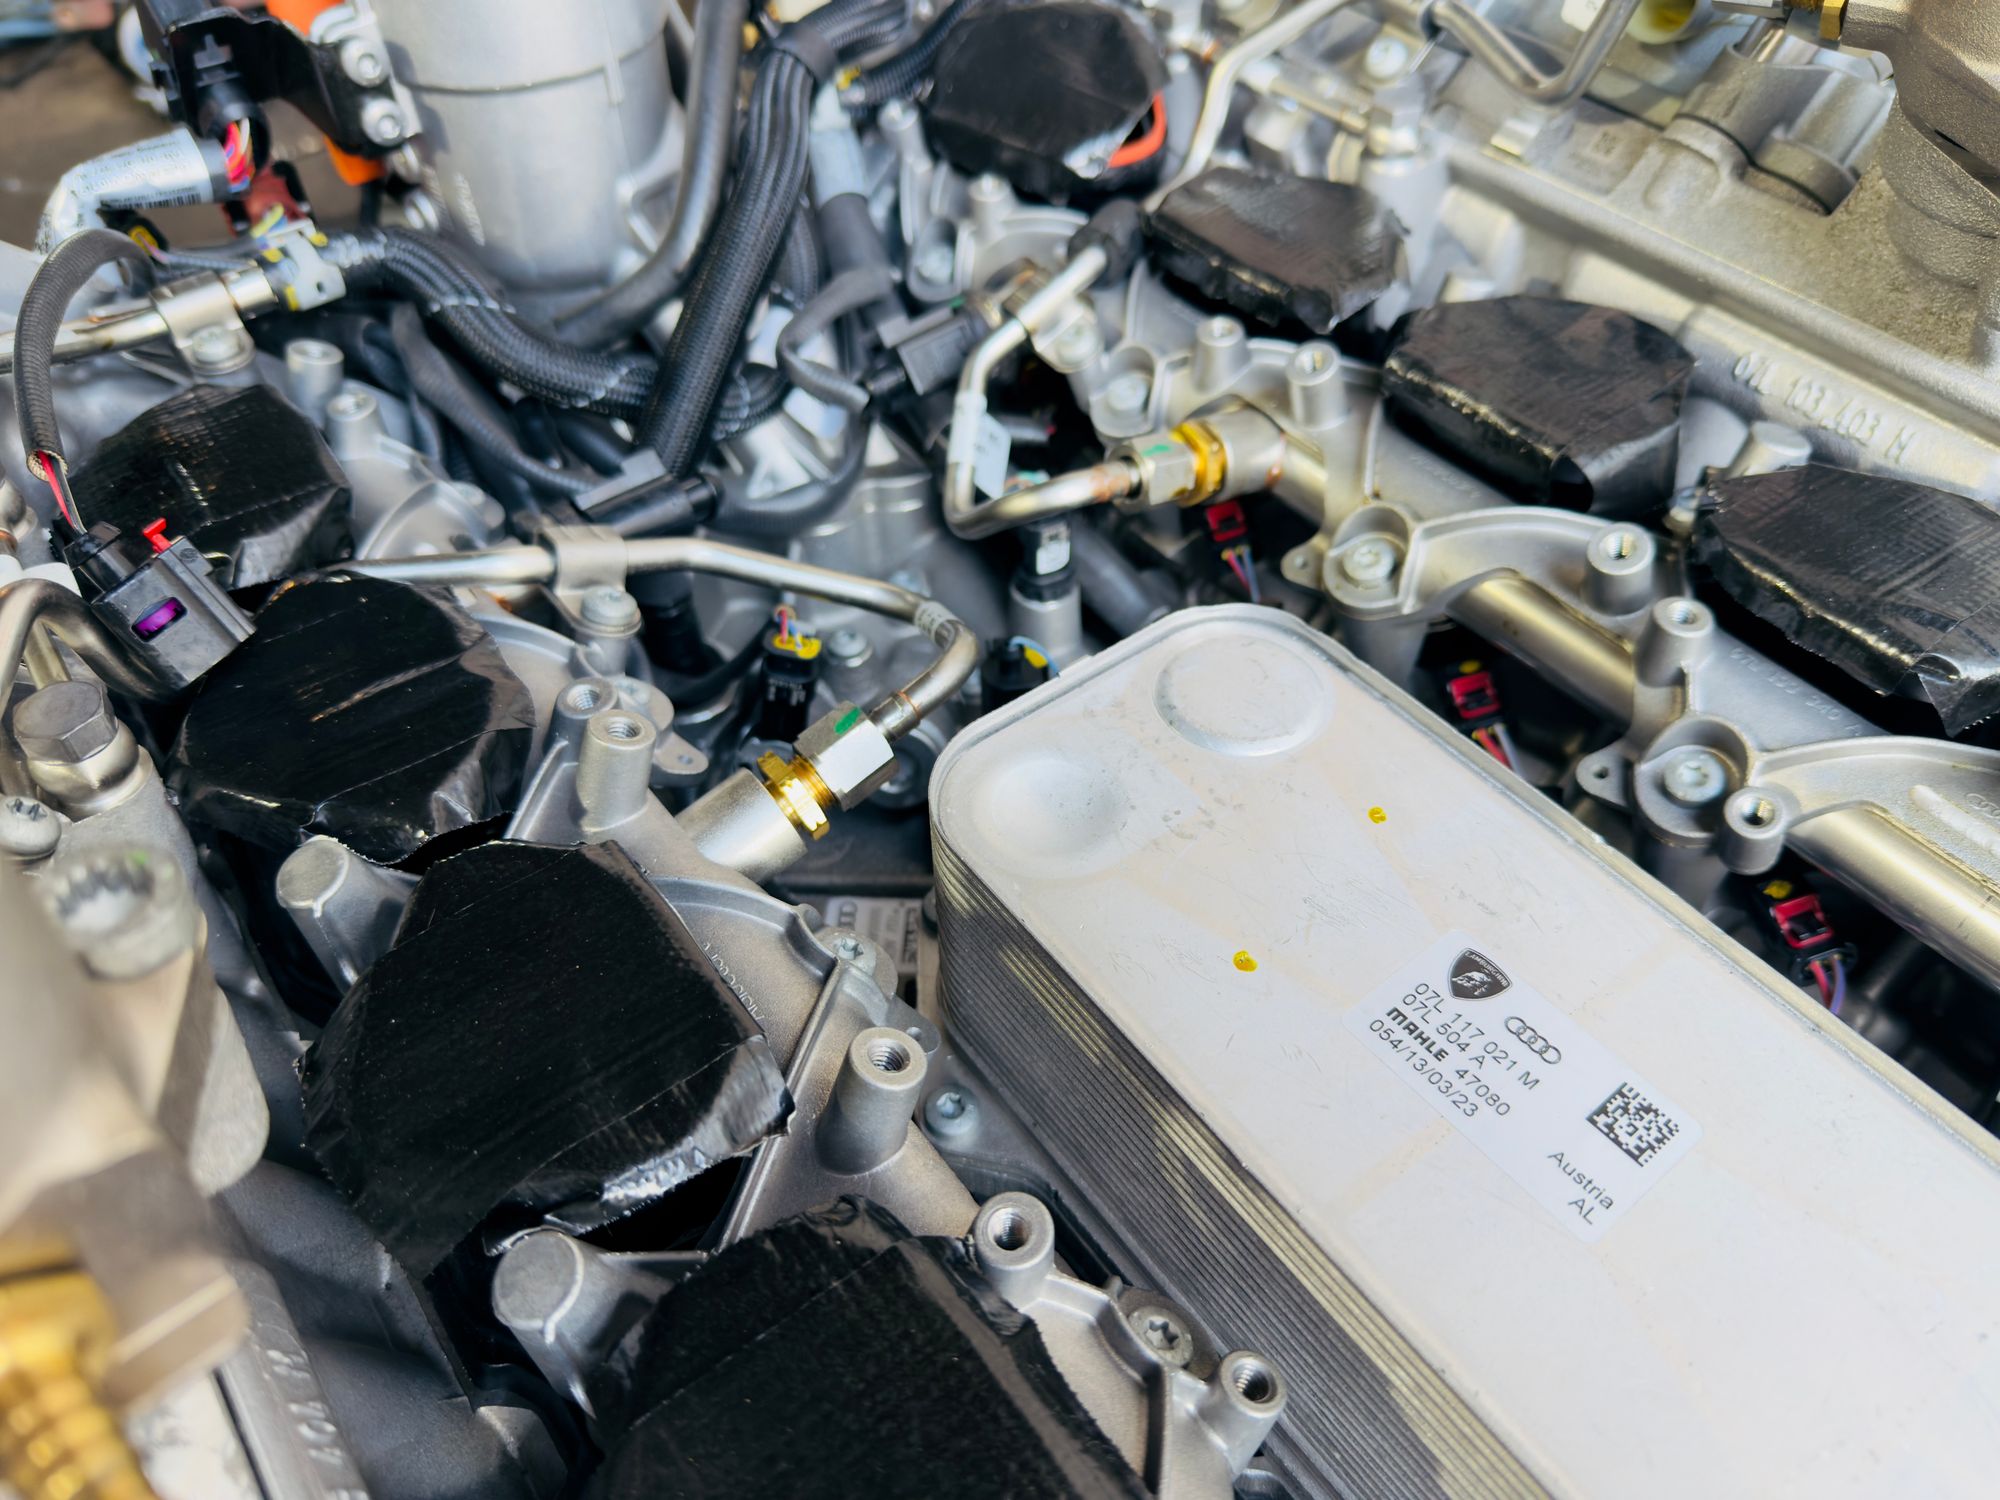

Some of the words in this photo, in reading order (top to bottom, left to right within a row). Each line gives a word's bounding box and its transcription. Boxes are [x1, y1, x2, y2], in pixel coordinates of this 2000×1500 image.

[1369, 1019, 1479, 1117] 054/13/03/23
[1386, 1007, 1449, 1062] MAHLE
[1455, 1068, 1511, 1117] 47080
[1402, 993, 1432, 1025] 07L
[1436, 1022, 1470, 1053] 504
[1469, 1055, 1486, 1070] A
[1415, 983, 1445, 1013] 07L
[1450, 1013, 1485, 1039] 117
[1483, 1041, 1518, 1071] 021
[1517, 1070, 1541, 1090] M
[1547, 1152, 1614, 1210] Austria
[1568, 1198, 1594, 1225] AL
